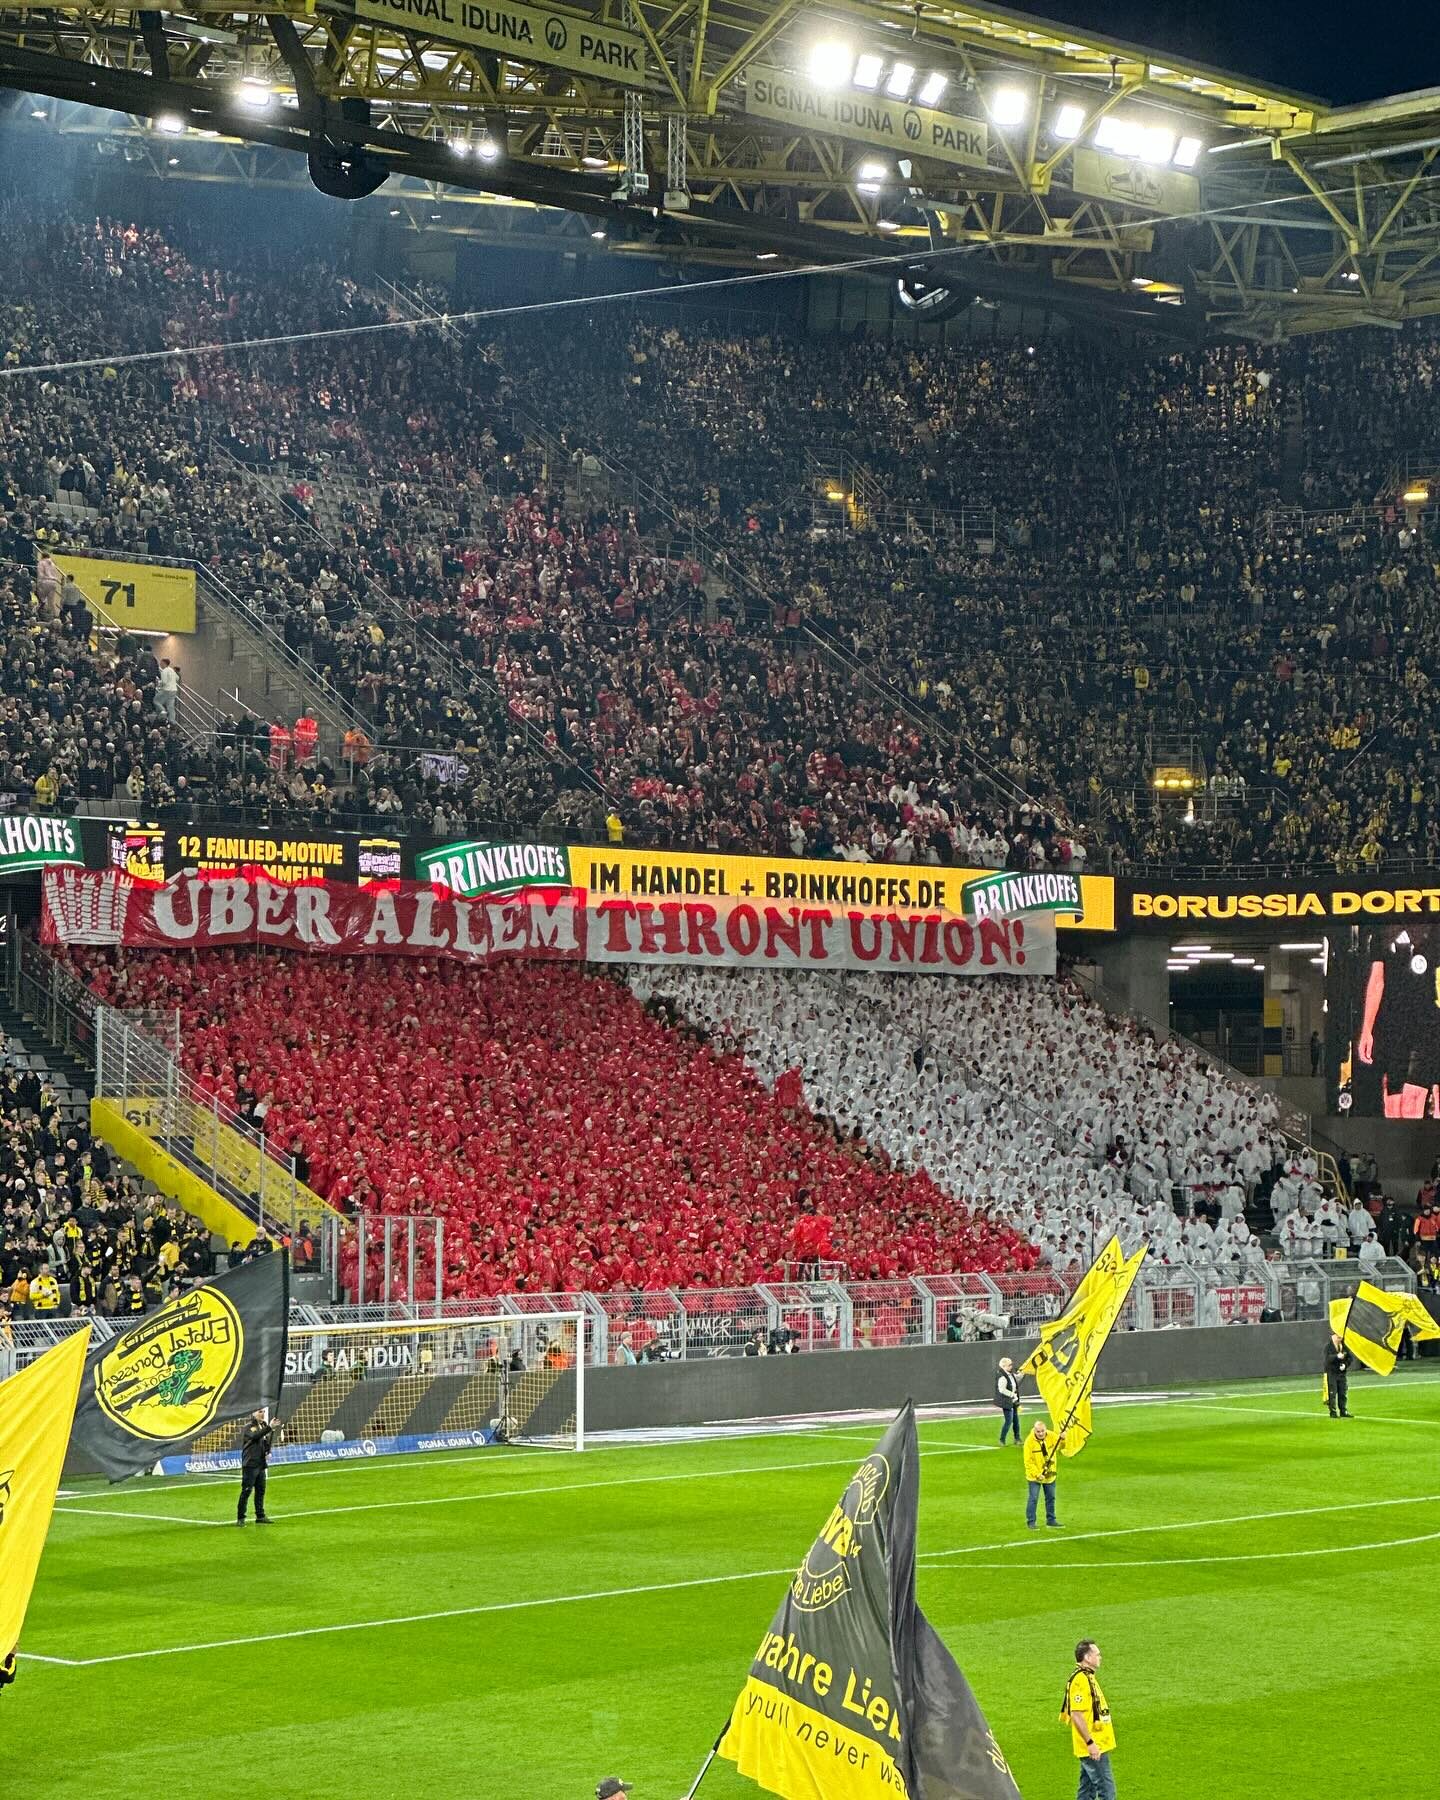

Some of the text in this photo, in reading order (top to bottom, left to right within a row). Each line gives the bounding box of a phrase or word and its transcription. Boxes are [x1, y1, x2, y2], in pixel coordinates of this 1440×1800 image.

[461, 3, 533, 44] IDUNA
[579, 36, 639, 72] PARK
[753, 80, 982, 156] SIGNAL IDUNA PARK
[100, 579, 136, 608] 71
[177, 836, 200, 858] 12
[206, 837, 343, 865] FANLIED-MOTIVE
[590, 862, 945, 907] IM HANDEL + BRINKHOFFS.DE
[153, 866, 1027, 966] ÜBER ALLEM THRONT UNION!
[1132, 892, 1327, 918] BORUSSIA
[305, 1445, 364, 1460] SIGNAL IDUNA
[417, 1436, 473, 1449] SIGNAL IDUNA
[184, 1460, 218, 1473] SIGNAL
[801, 1574, 844, 1605] Liebe
[796, 1720, 870, 1770] never
